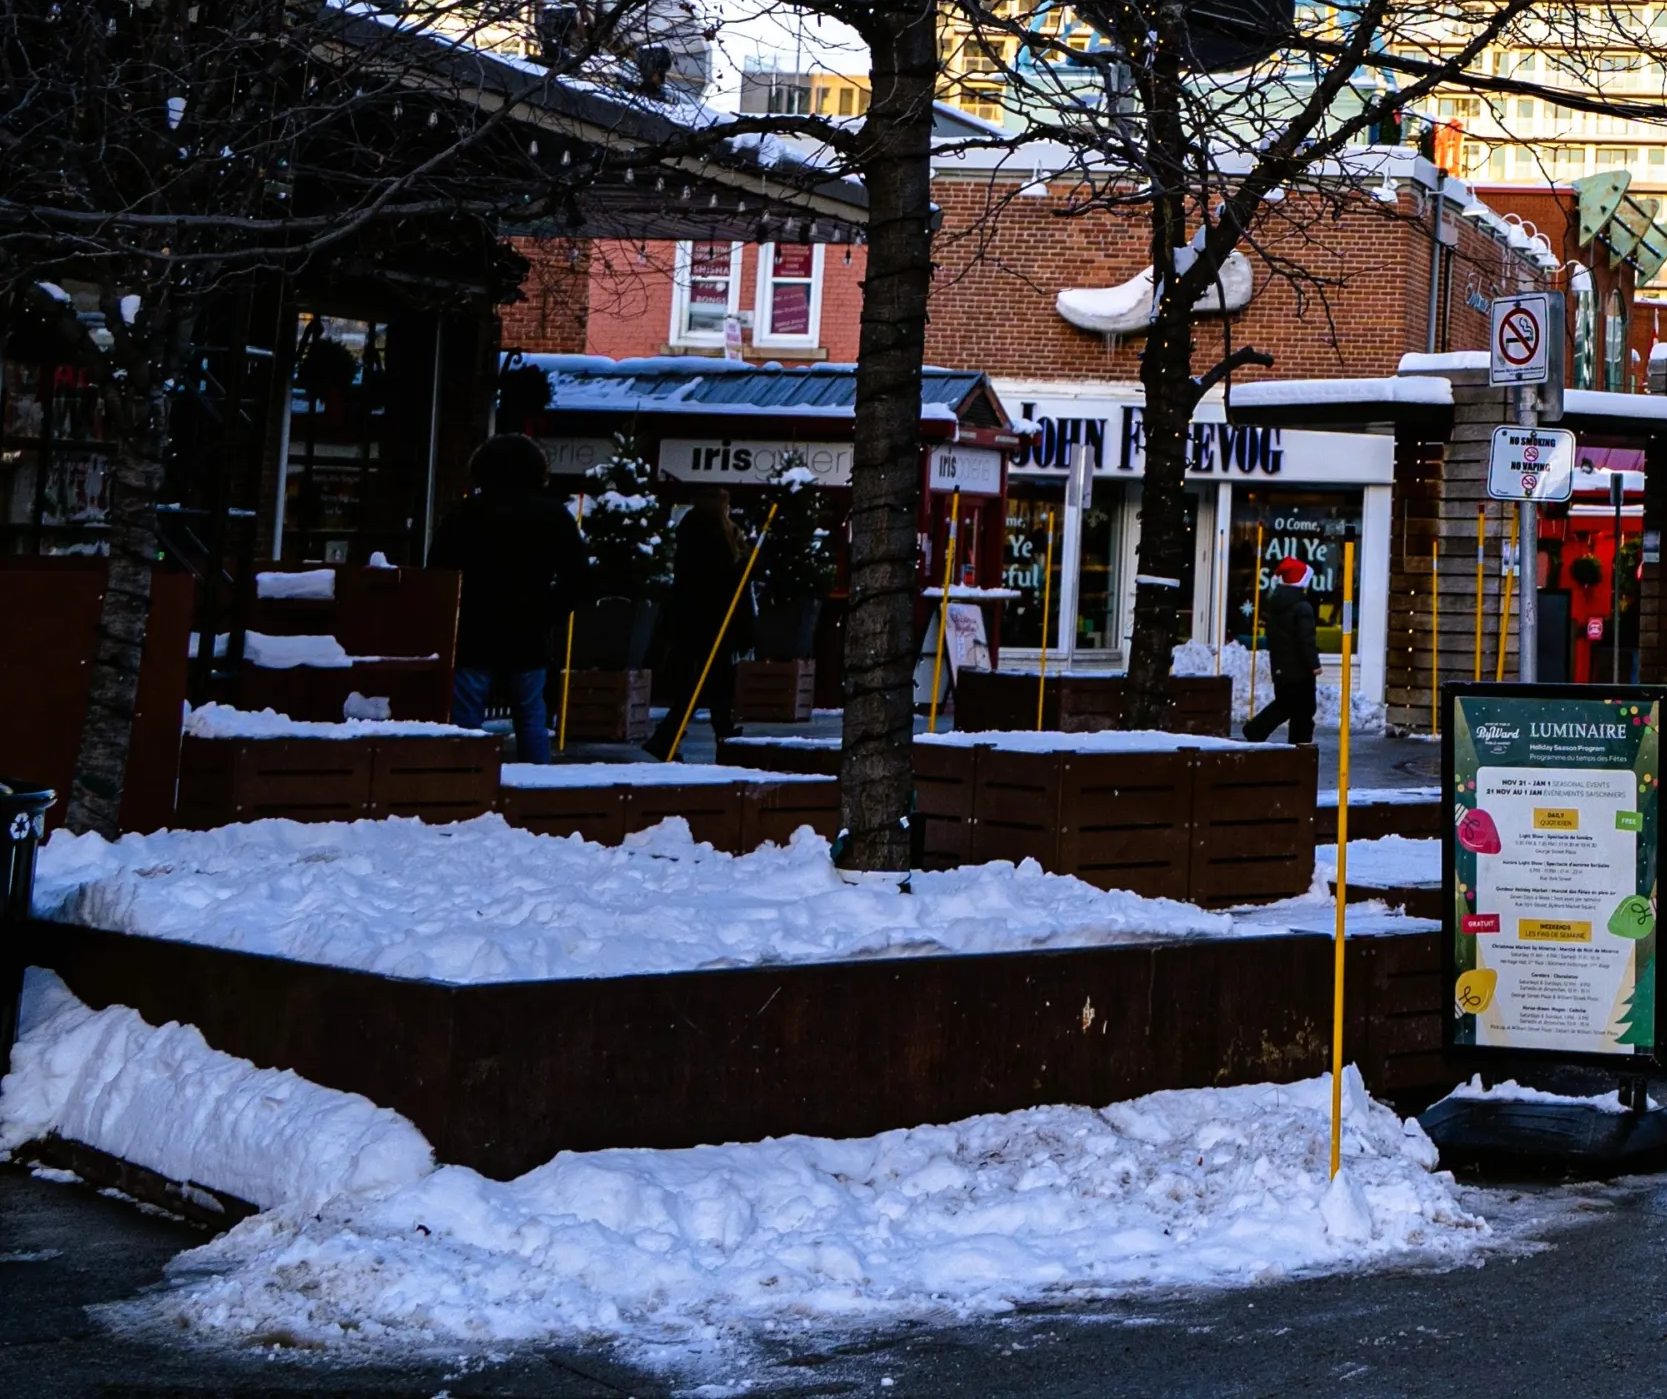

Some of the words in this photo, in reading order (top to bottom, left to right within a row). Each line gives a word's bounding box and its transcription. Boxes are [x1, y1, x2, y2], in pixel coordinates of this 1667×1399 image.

[693, 265, 729, 275] SHISHA
[1010, 402, 1108, 469] JOHN
[1117, 405, 1284, 474] FEVOG
[1510, 436, 1519, 445] NO
[1521, 437, 1556, 447] SMOKING
[1511, 462, 1520, 470] NO
[1522, 463, 1550, 472] VAPING
[1006, 517, 1027, 529] me,
[1274, 517, 1284, 530] O
[1286, 518, 1321, 532] Come,
[1009, 534, 1033, 558] Ye
[1265, 537, 1298, 561] All
[1303, 538, 1328, 562] Ye
[1476, 726, 1520, 741] ByWard
[1529, 722, 1627, 739] LUMINAIRE
[1530, 744, 1553, 752] Holiday
[1577, 745, 1605, 753] Program
[1530, 754, 1566, 762] Programme
[1576, 755, 1596, 763] temps
[1540, 819, 1573, 827] QUOTIDIEN
[1621, 817, 1636, 826] FREE
[1468, 920, 1494, 928] GRATUIT
[1559, 931, 1586, 939] SEMAINE
